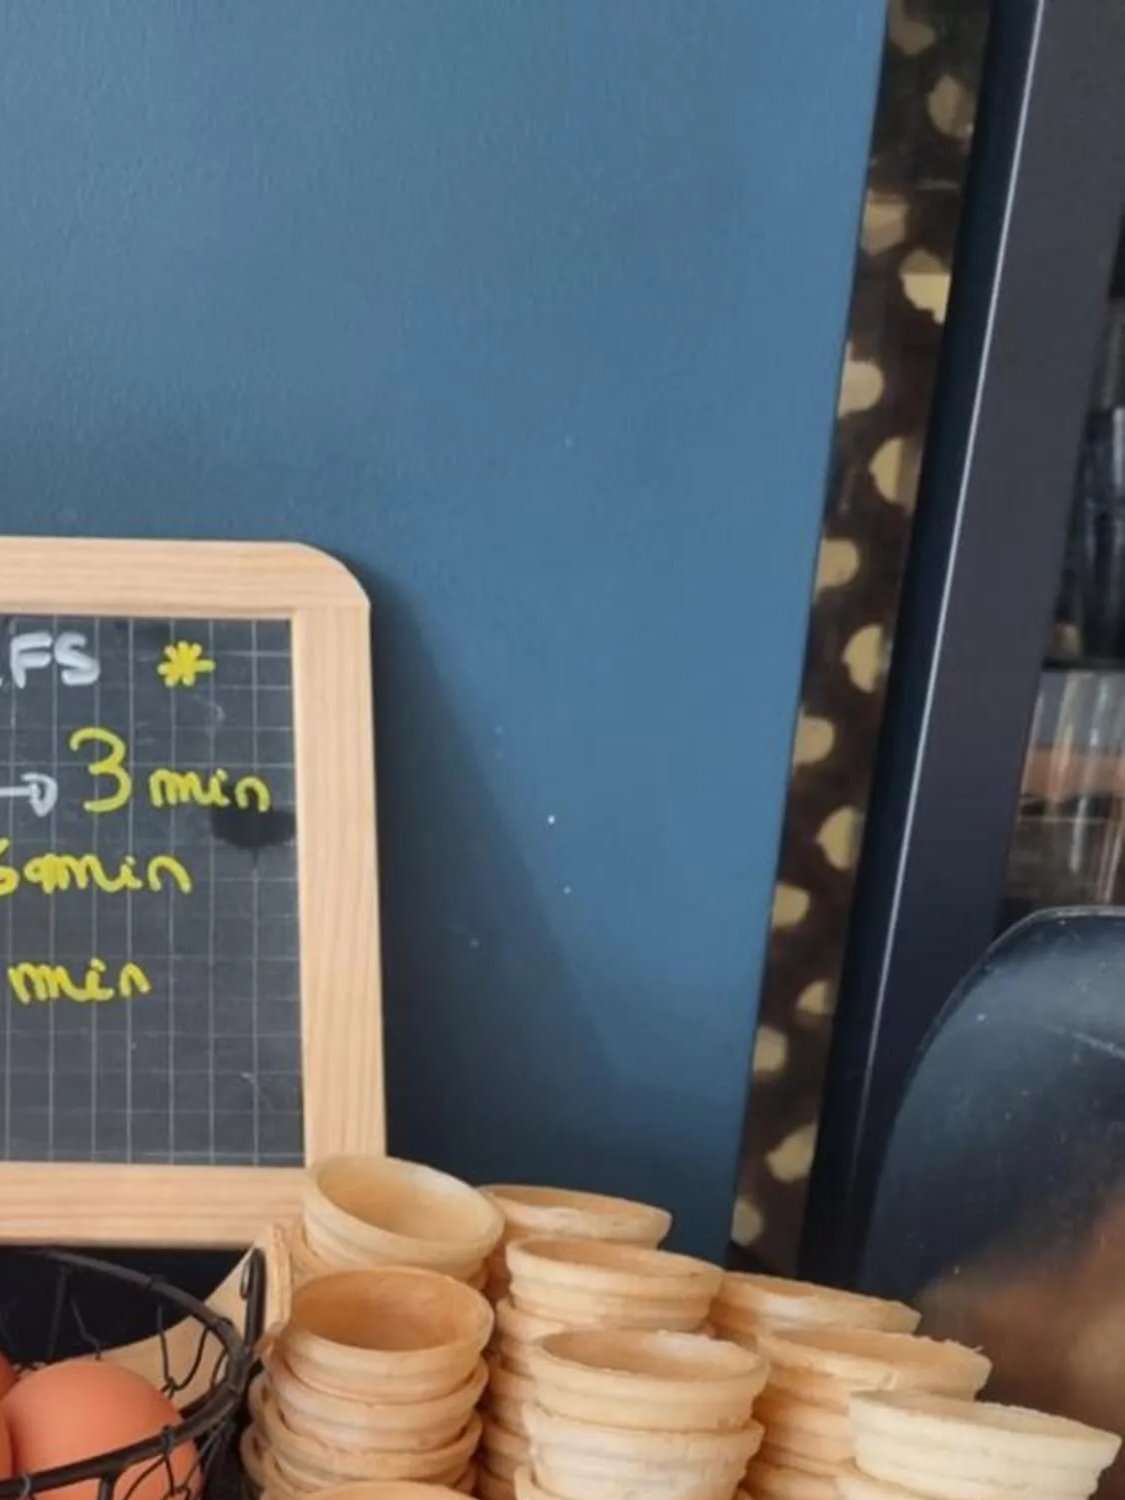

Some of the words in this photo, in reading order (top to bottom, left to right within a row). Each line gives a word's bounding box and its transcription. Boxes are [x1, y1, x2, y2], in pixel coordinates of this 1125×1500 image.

[70, 727, 132, 813] 3
[149, 767, 271, 812] min
[7, 957, 151, 1003] min
